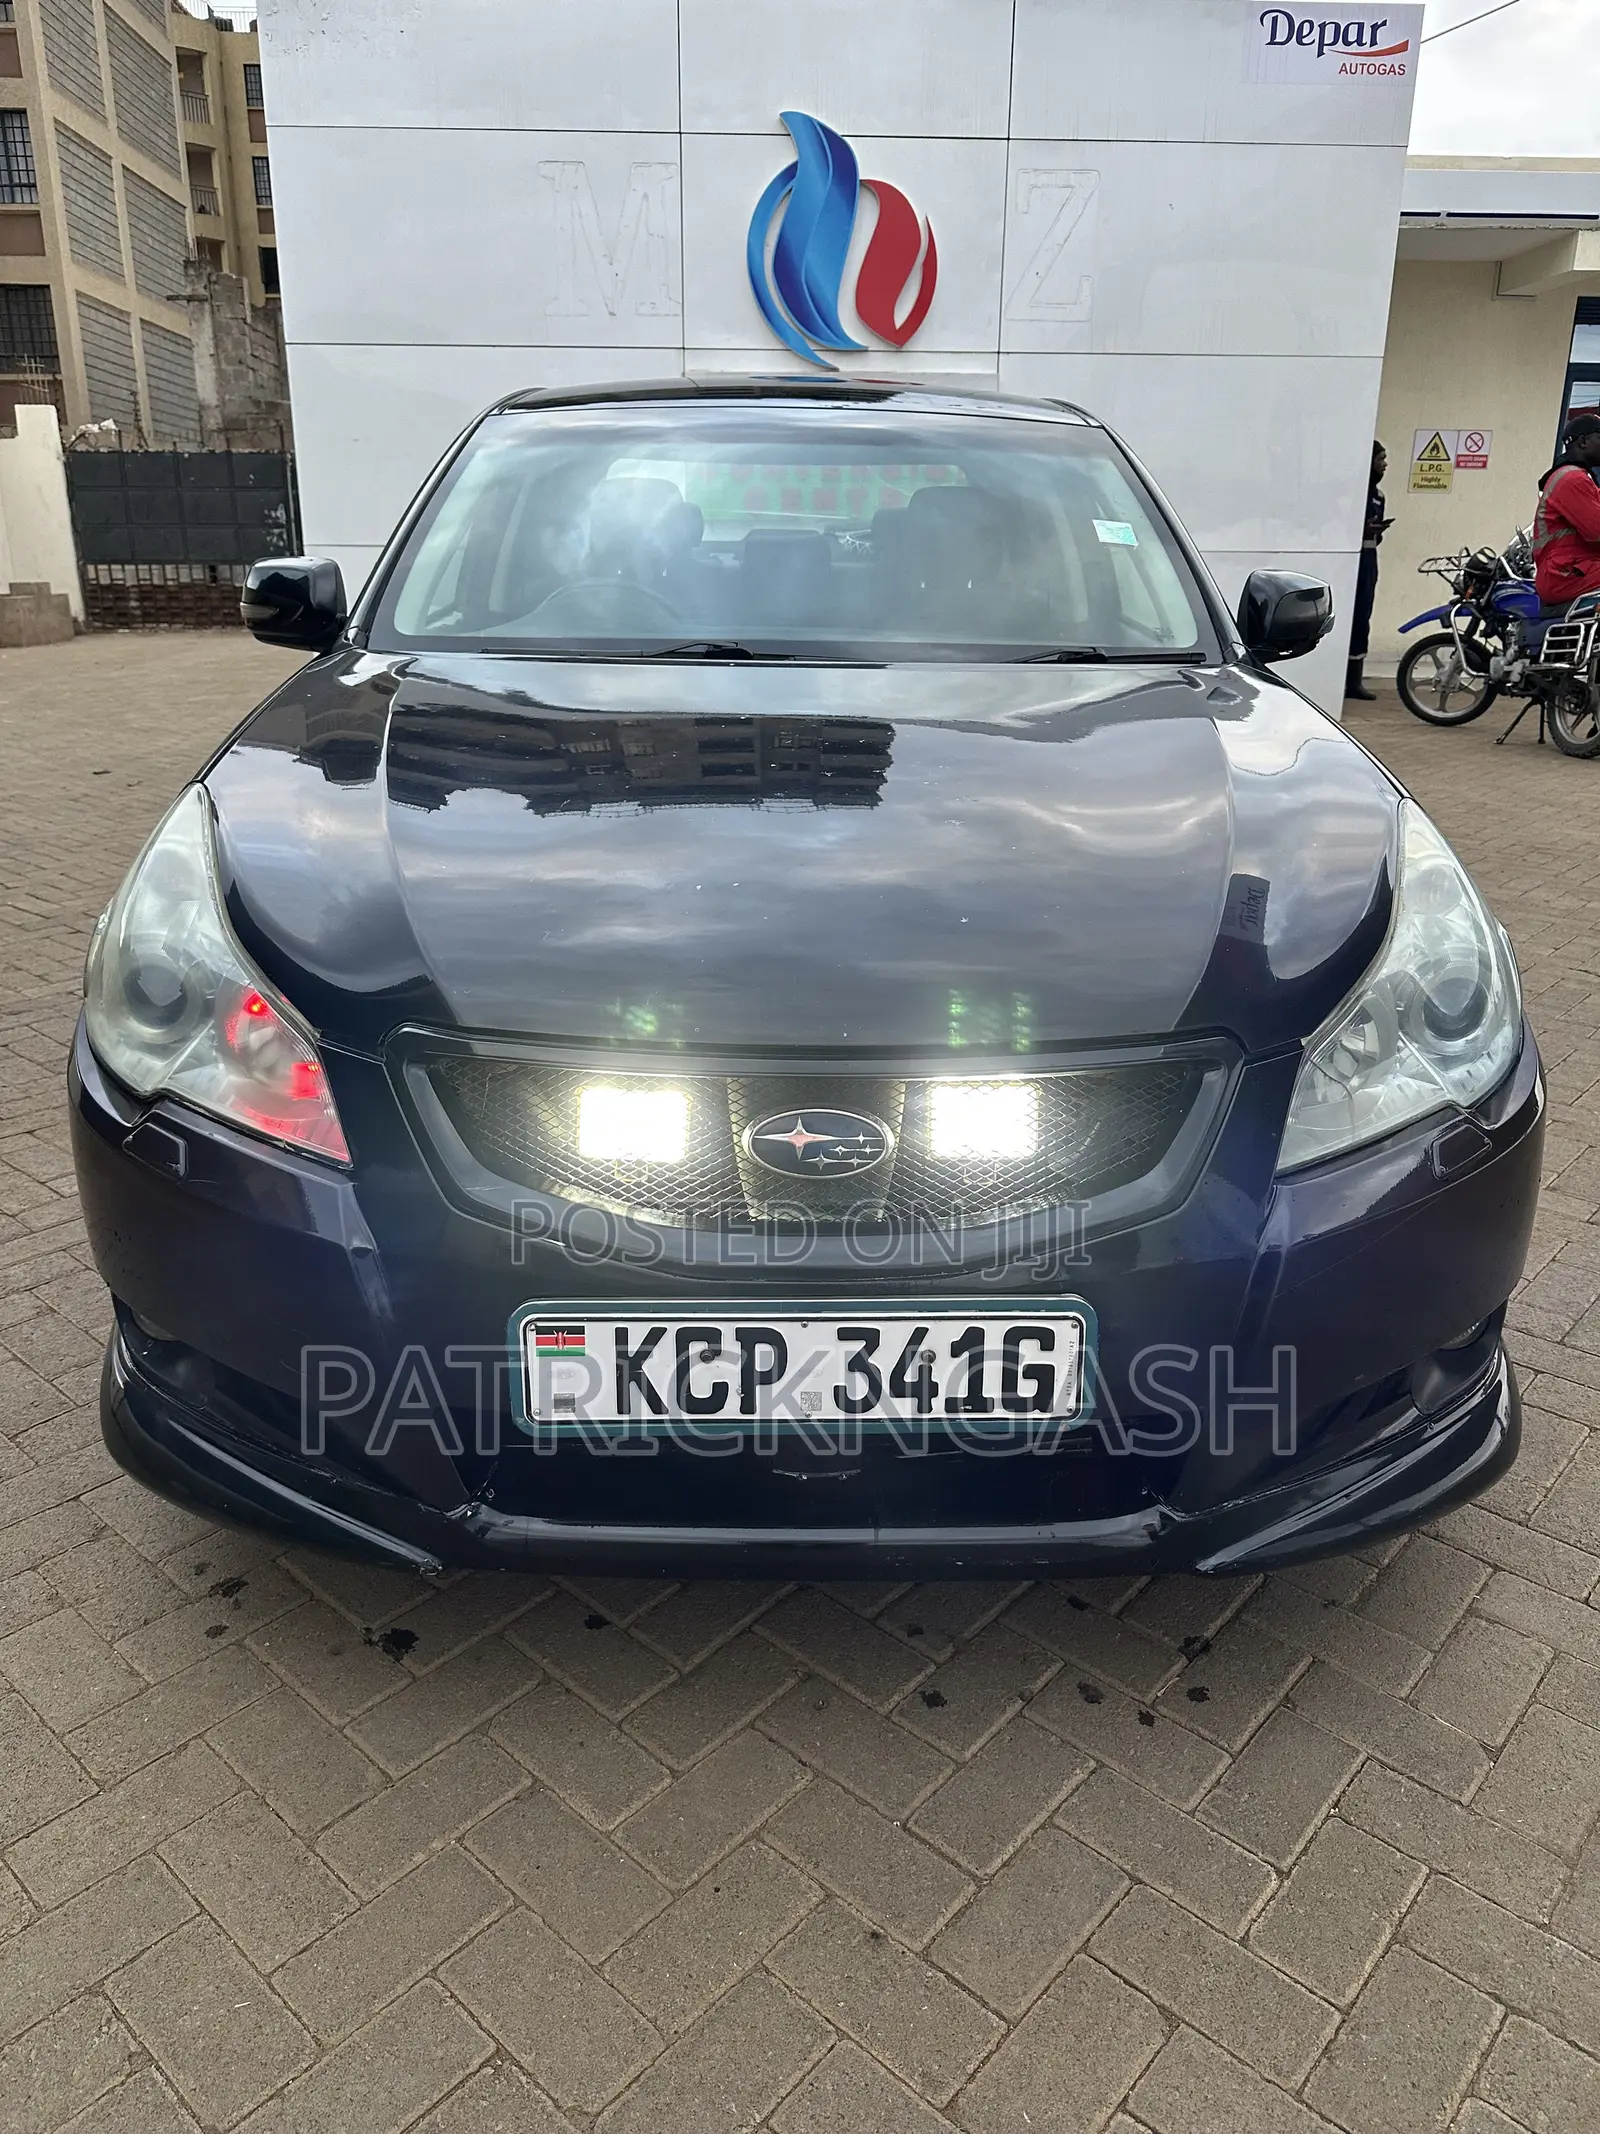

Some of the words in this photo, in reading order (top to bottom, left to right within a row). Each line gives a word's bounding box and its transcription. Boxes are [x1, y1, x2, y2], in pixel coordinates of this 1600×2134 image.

[1259, 9, 1388, 58] Depar
[1338, 62, 1407, 76] AUTOGAS
[1419, 463, 1445, 472] L.P.G.
[614, 1326, 788, 1415] KCP
[832, 1326, 1056, 1414] 341G
